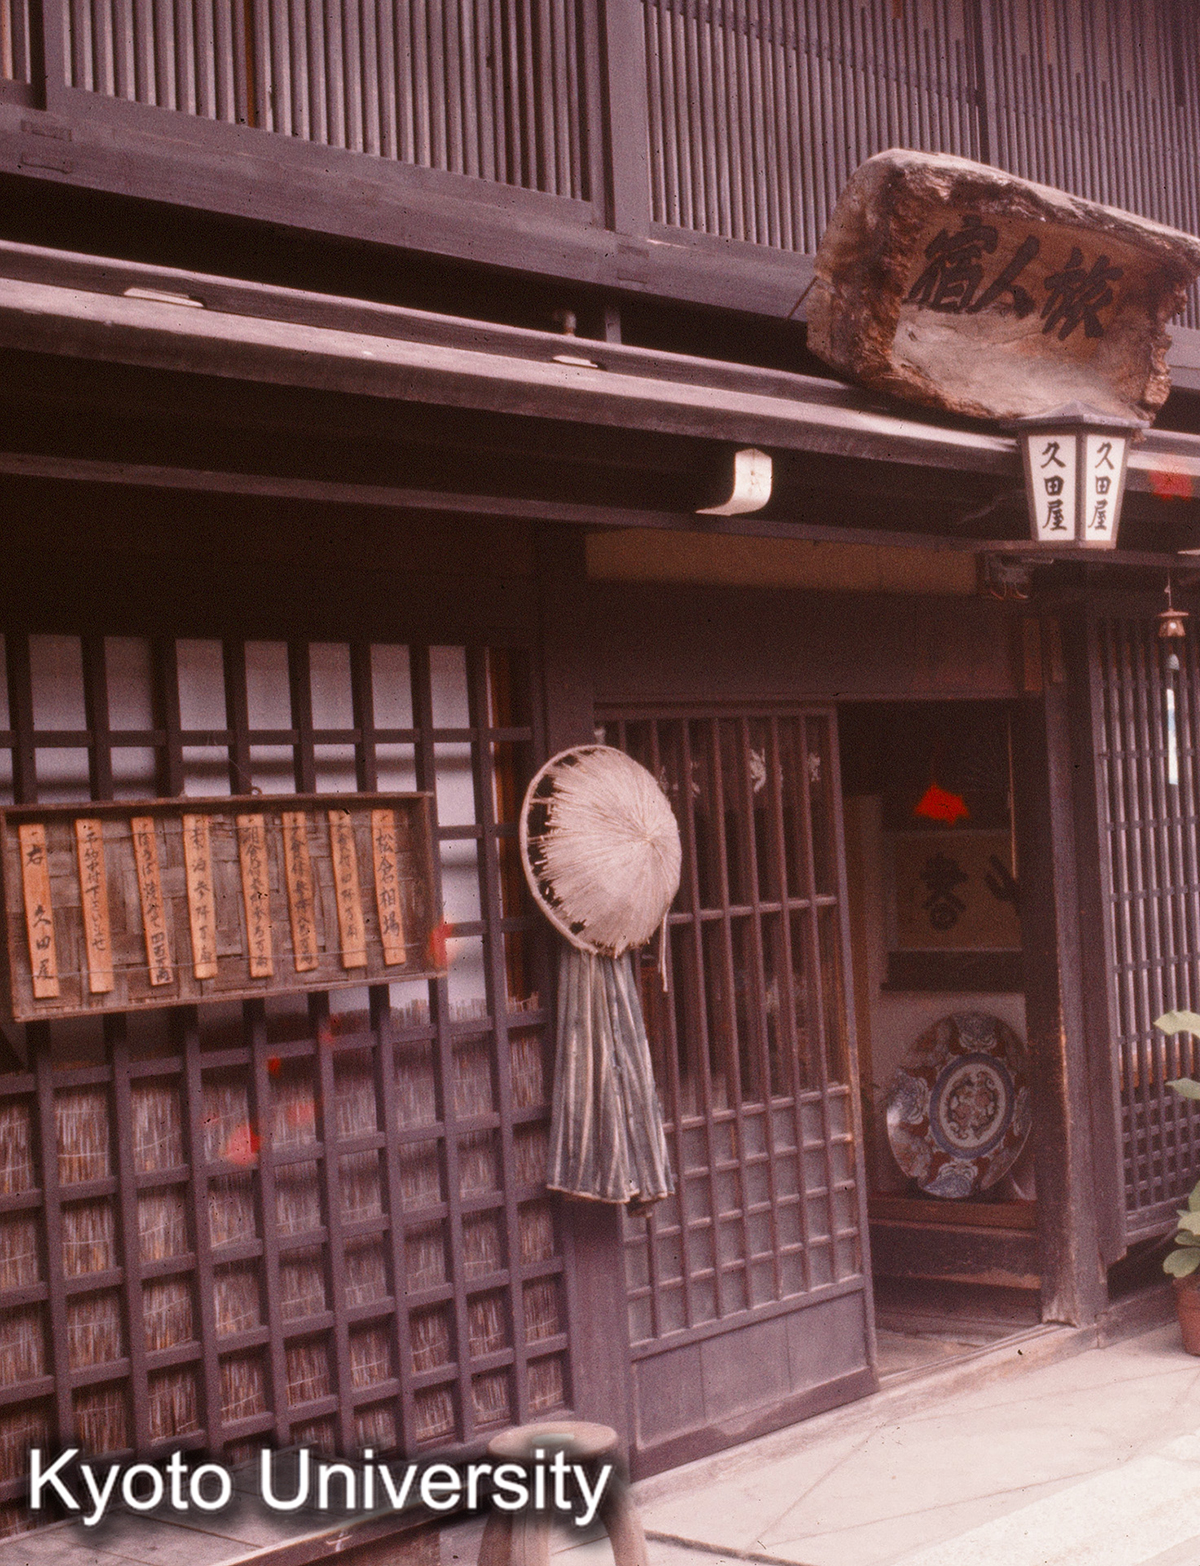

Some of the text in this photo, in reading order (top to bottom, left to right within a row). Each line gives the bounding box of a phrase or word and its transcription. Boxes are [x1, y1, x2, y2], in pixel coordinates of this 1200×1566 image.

[1040, 441, 1067, 531] 久田屋
[1088, 441, 1115, 531] 久田屋
